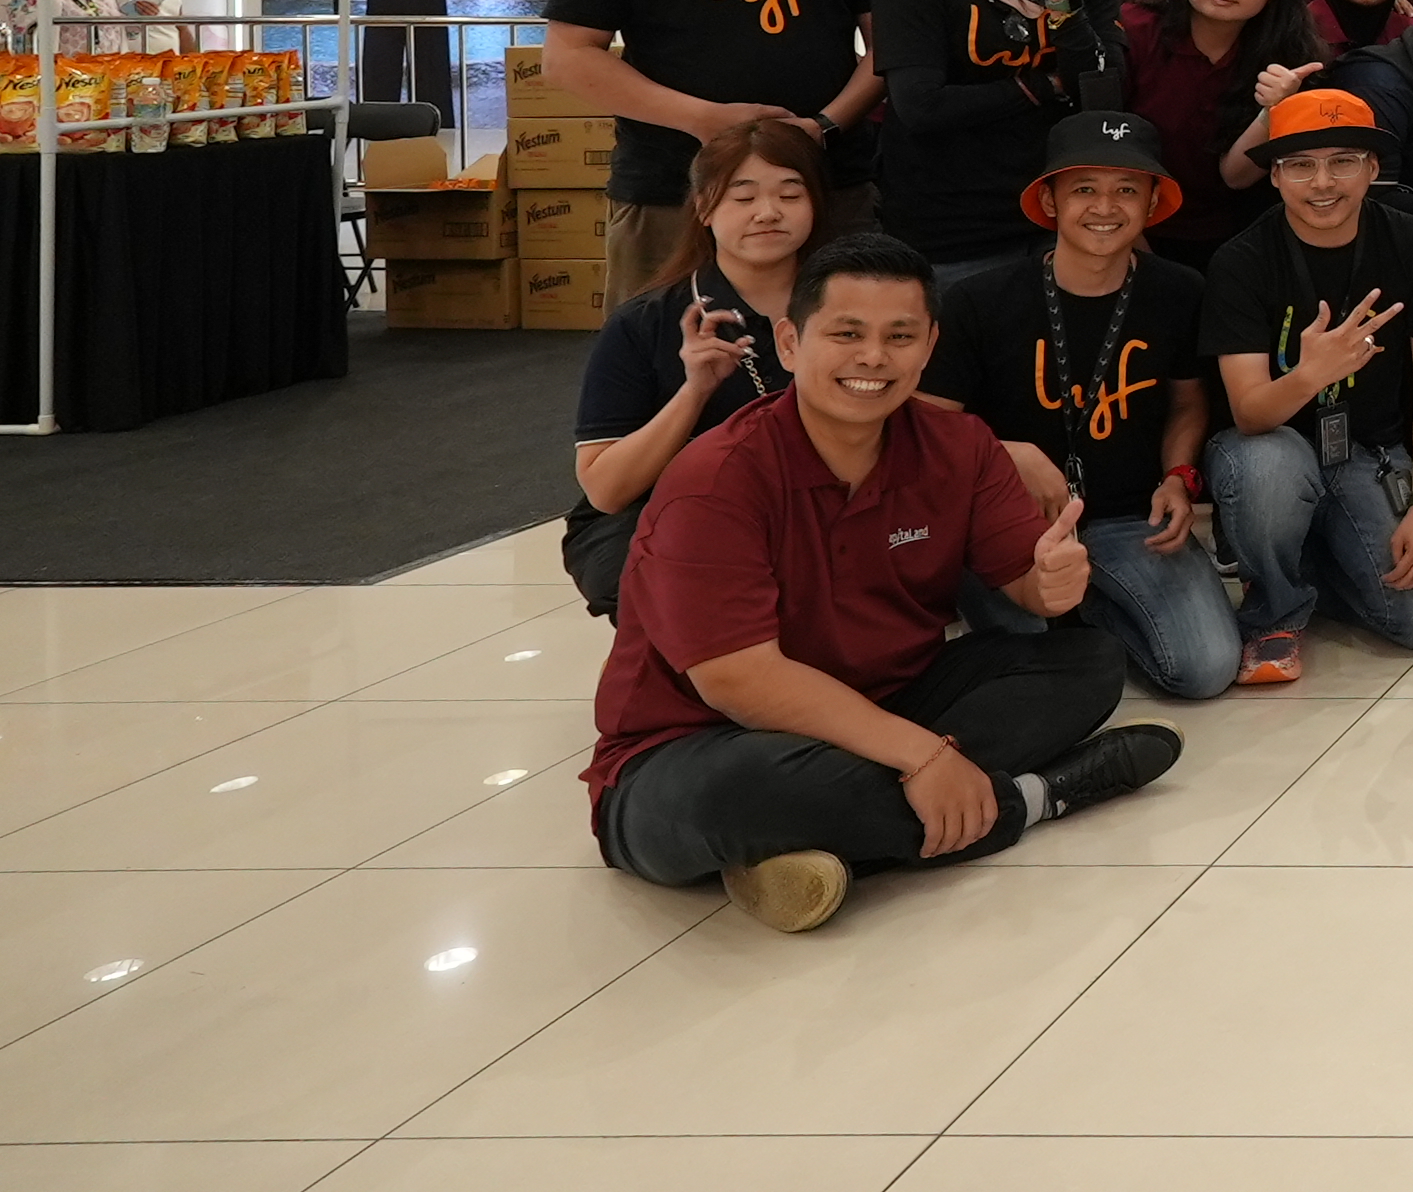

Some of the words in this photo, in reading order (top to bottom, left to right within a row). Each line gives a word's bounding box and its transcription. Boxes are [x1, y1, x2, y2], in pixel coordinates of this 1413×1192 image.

[513, 61, 542, 84] Nest
[1102, 121, 1131, 141] lyf
[1035, 338, 1158, 440] lyf
[888, 524, 930, 545] apitaLand
